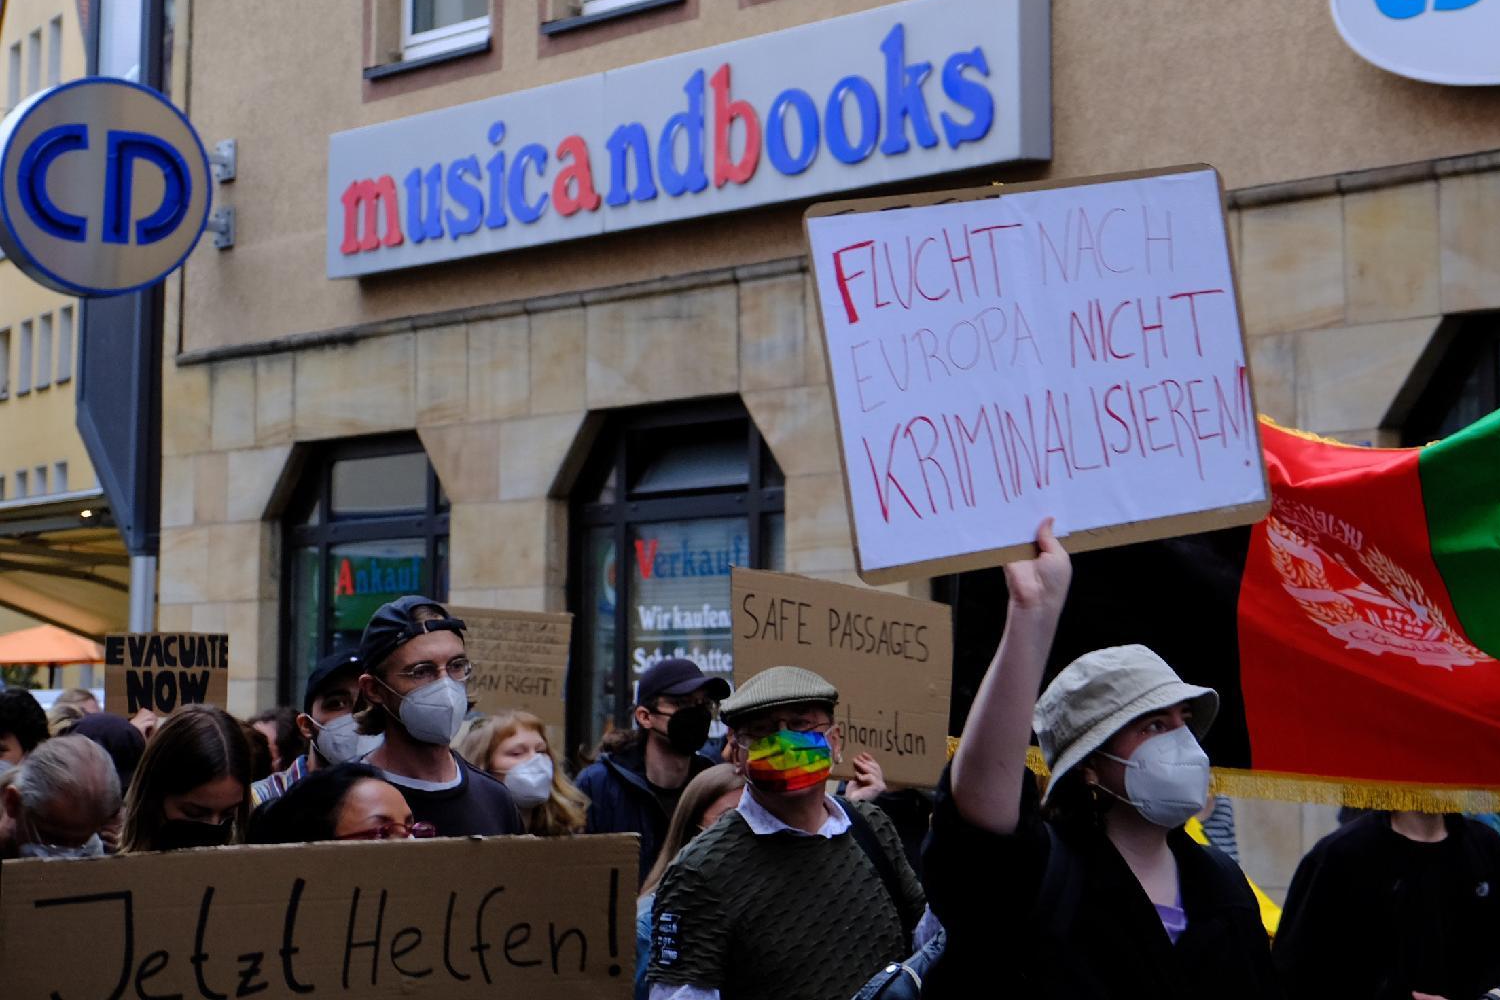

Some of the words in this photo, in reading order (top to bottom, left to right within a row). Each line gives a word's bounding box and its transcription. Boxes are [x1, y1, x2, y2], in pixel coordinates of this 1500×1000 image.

[17, 123, 193, 245] CD
[832, 222, 1024, 324] FLUCHT
[1037, 205, 1175, 286] NACH
[1069, 289, 1226, 369] NICHT
[861, 360, 1252, 524] KRIMINALISIEREN!
[336, 555, 422, 596] Ankauf
[634, 535, 744, 579] Verkauf
[105, 634, 229, 669] EVACUATE
[742, 593, 812, 645] SAFE
[828, 607, 930, 663] PASSAGES
[126, 669, 210, 714] NOW
[34, 878, 315, 1000] Jetzt
[342, 868, 620, 990] Helfen!
